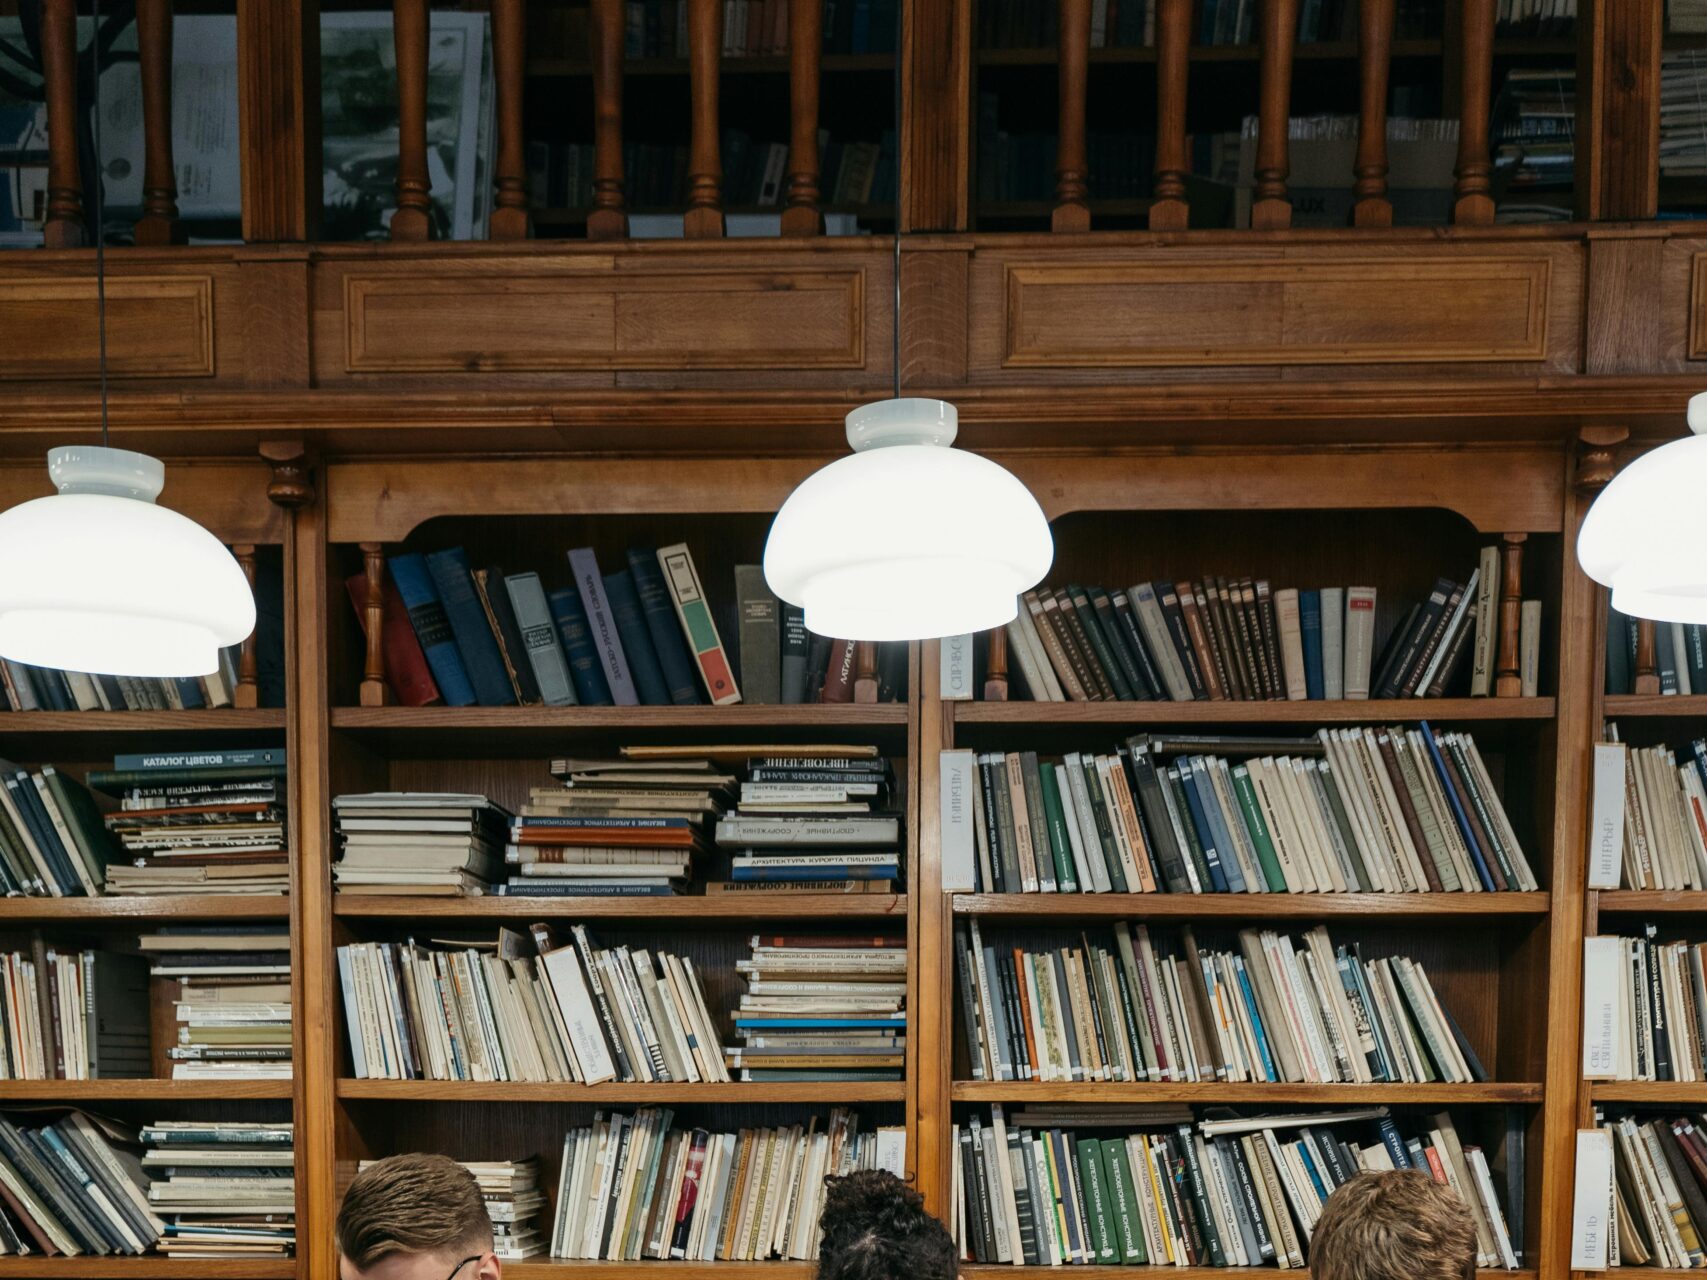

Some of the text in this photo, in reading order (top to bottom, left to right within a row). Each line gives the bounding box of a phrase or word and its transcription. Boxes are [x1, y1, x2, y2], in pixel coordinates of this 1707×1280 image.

[142, 754, 185, 767] КАТАЛОГ
[185, 754, 223, 766] ЦВЕТОВ
[763, 757, 849, 769] ЦВЕТОВЕДЕНИЕ
[951, 767, 962, 824] УЧЕБНИКИ
[1601, 817, 1615, 875] ИНТЕРЬЕР
[722, 882, 787, 890] СООРУЖЕНИЯ
[578, 939, 602, 989] сооружени
[1649, 944, 1657, 973] солнце
[1653, 980, 1663, 1029] Архитектура
[1589, 1044, 1600, 1068] СВЕТ
[1184, 1132, 1203, 1196] История архитектур
[1321, 1134, 1346, 1184] ИСТОРИЯ РУССК
[1387, 1131, 1407, 1170] СТРОИТЕЛ
[1086, 1157, 1111, 1257] ЖЕЛЕЗОБЕТОННЫЕ КОНСТРУКЦ
[1110, 1157, 1134, 1256] ЖЕЛЕЗОБЕТОННЫЕ КОНСТРУКЦ
[1136, 1148, 1163, 1253] АРХИТЕКТУРНЫЕ КОНСТРУКЦИИ
[1237, 1161, 1248, 1184] ОСНОВЫ
[1244, 1183, 1260, 1222] СТРОИТЕЛЬНОЙ
[1256, 1142, 1272, 1175] ВВЕДЕНИЕ
[1268, 1180, 1290, 1230] СТРОИТЕЛЬНУЮ
[1284, 1230, 1297, 1256] ТЕХНИ
[1584, 1215, 1598, 1258] МЕБЕЛЬ
[1609, 1221, 1618, 1260] Встроенная
